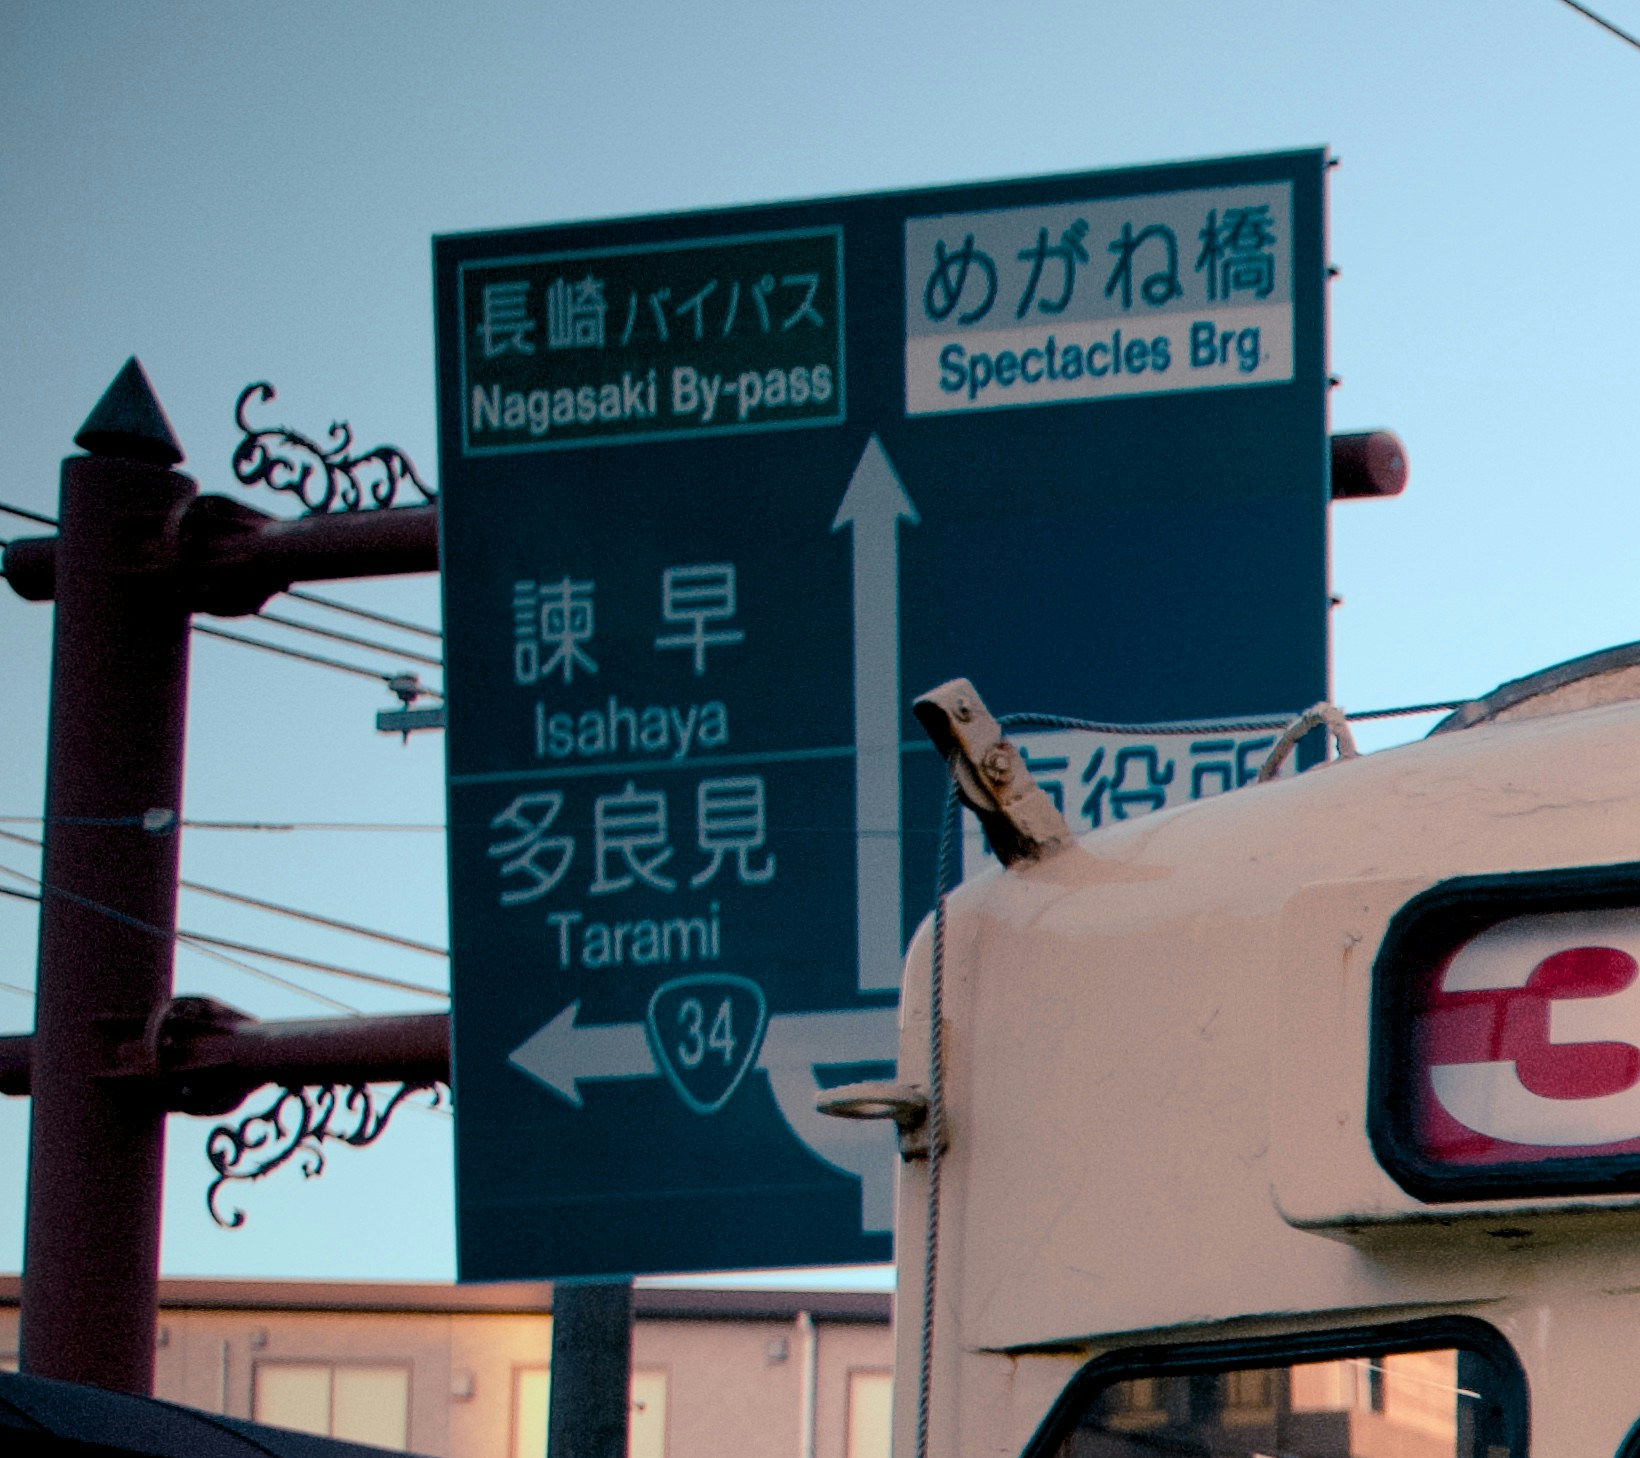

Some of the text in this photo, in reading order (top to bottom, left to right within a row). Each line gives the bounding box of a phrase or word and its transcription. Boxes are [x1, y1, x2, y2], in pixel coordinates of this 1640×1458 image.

[922, 204, 1278, 324] めがね橋
[476, 271, 825, 358] 長崎バイパス
[471, 363, 835, 436] Nagasaki By-pass
[938, 328, 1172, 402] Spectacles
[512, 562, 746, 686] 諫早
[535, 698, 729, 760] Isahaya
[488, 774, 778, 906] 多良見
[547, 902, 722, 968] Tarami
[676, 1000, 736, 1068] 34
